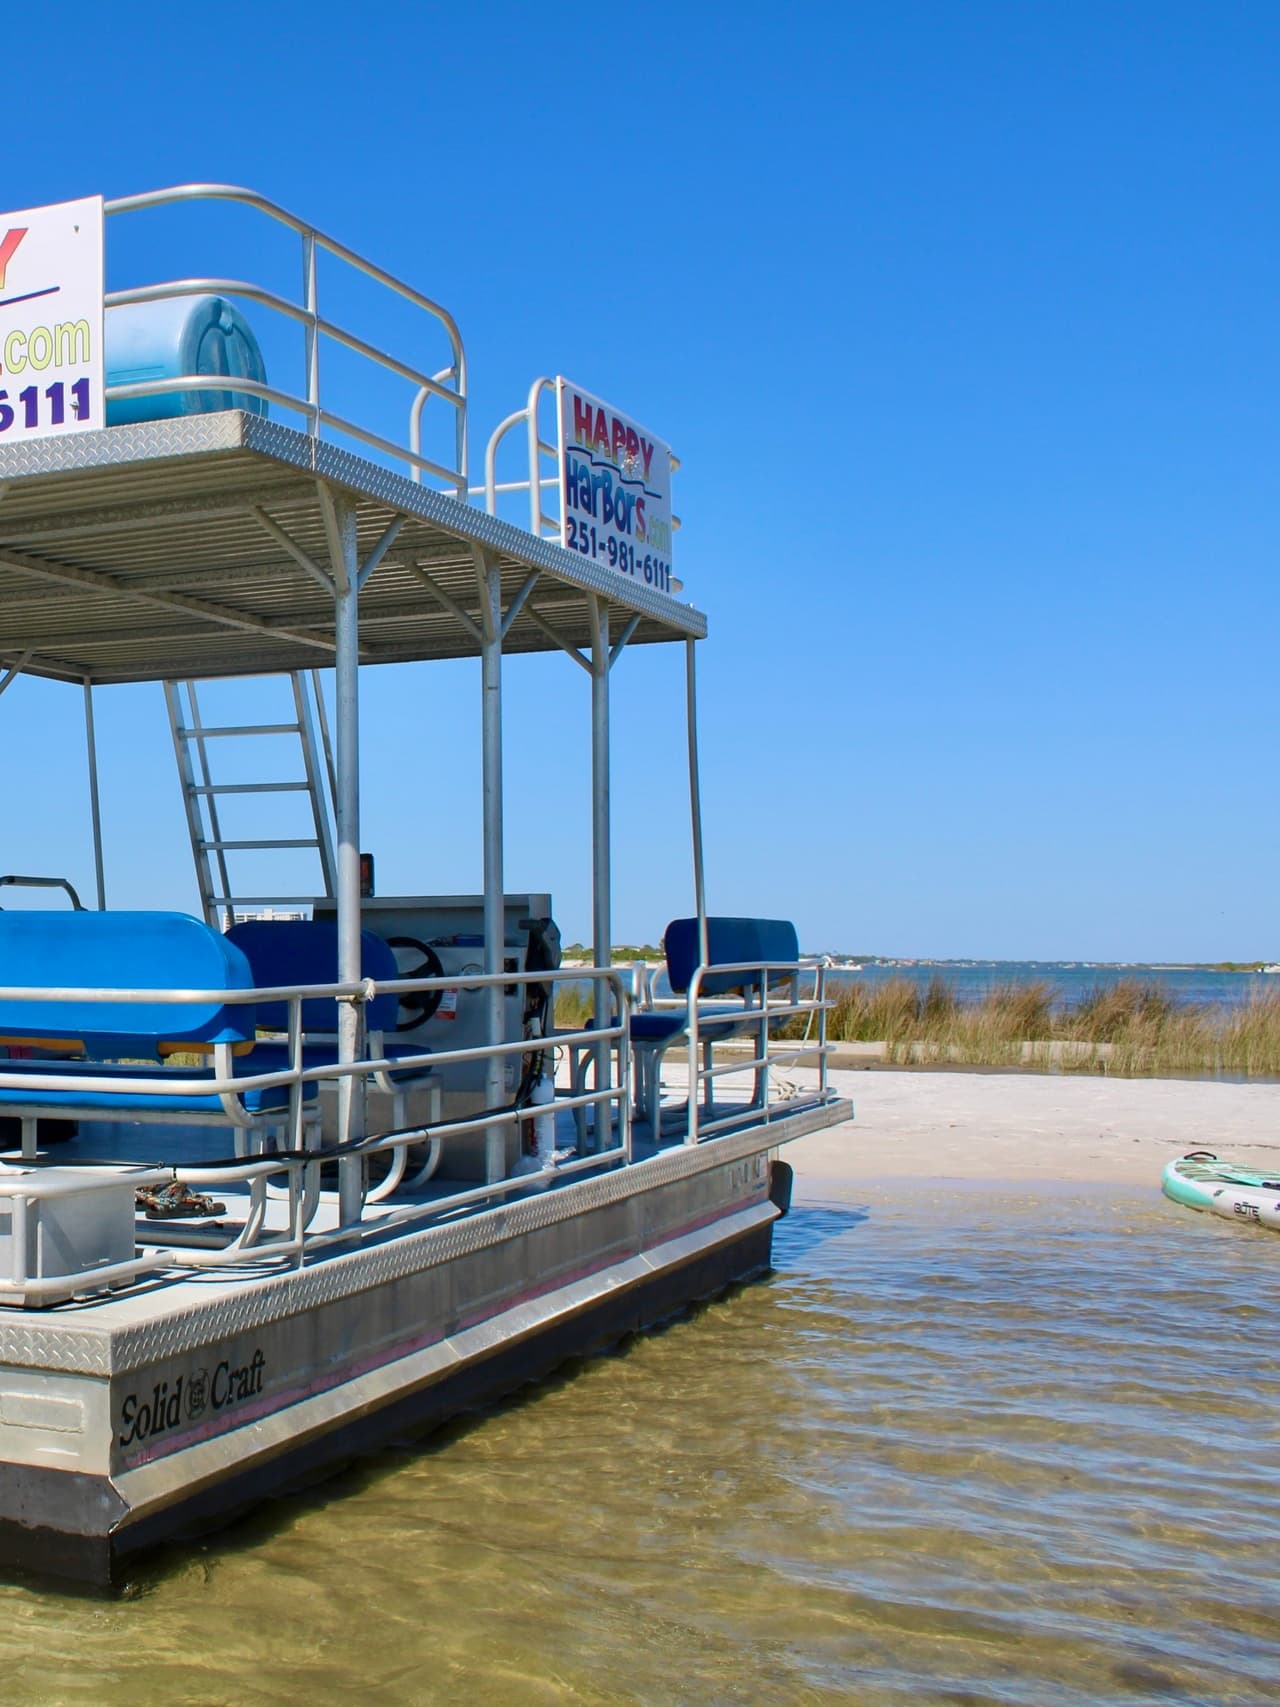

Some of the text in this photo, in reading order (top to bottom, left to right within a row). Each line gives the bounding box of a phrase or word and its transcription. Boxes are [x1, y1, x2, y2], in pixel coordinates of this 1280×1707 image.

[574, 394, 654, 483] HAPPY
[567, 516, 670, 592] 251-981-6111
[120, 1348, 266, 1447] Solid Craft
